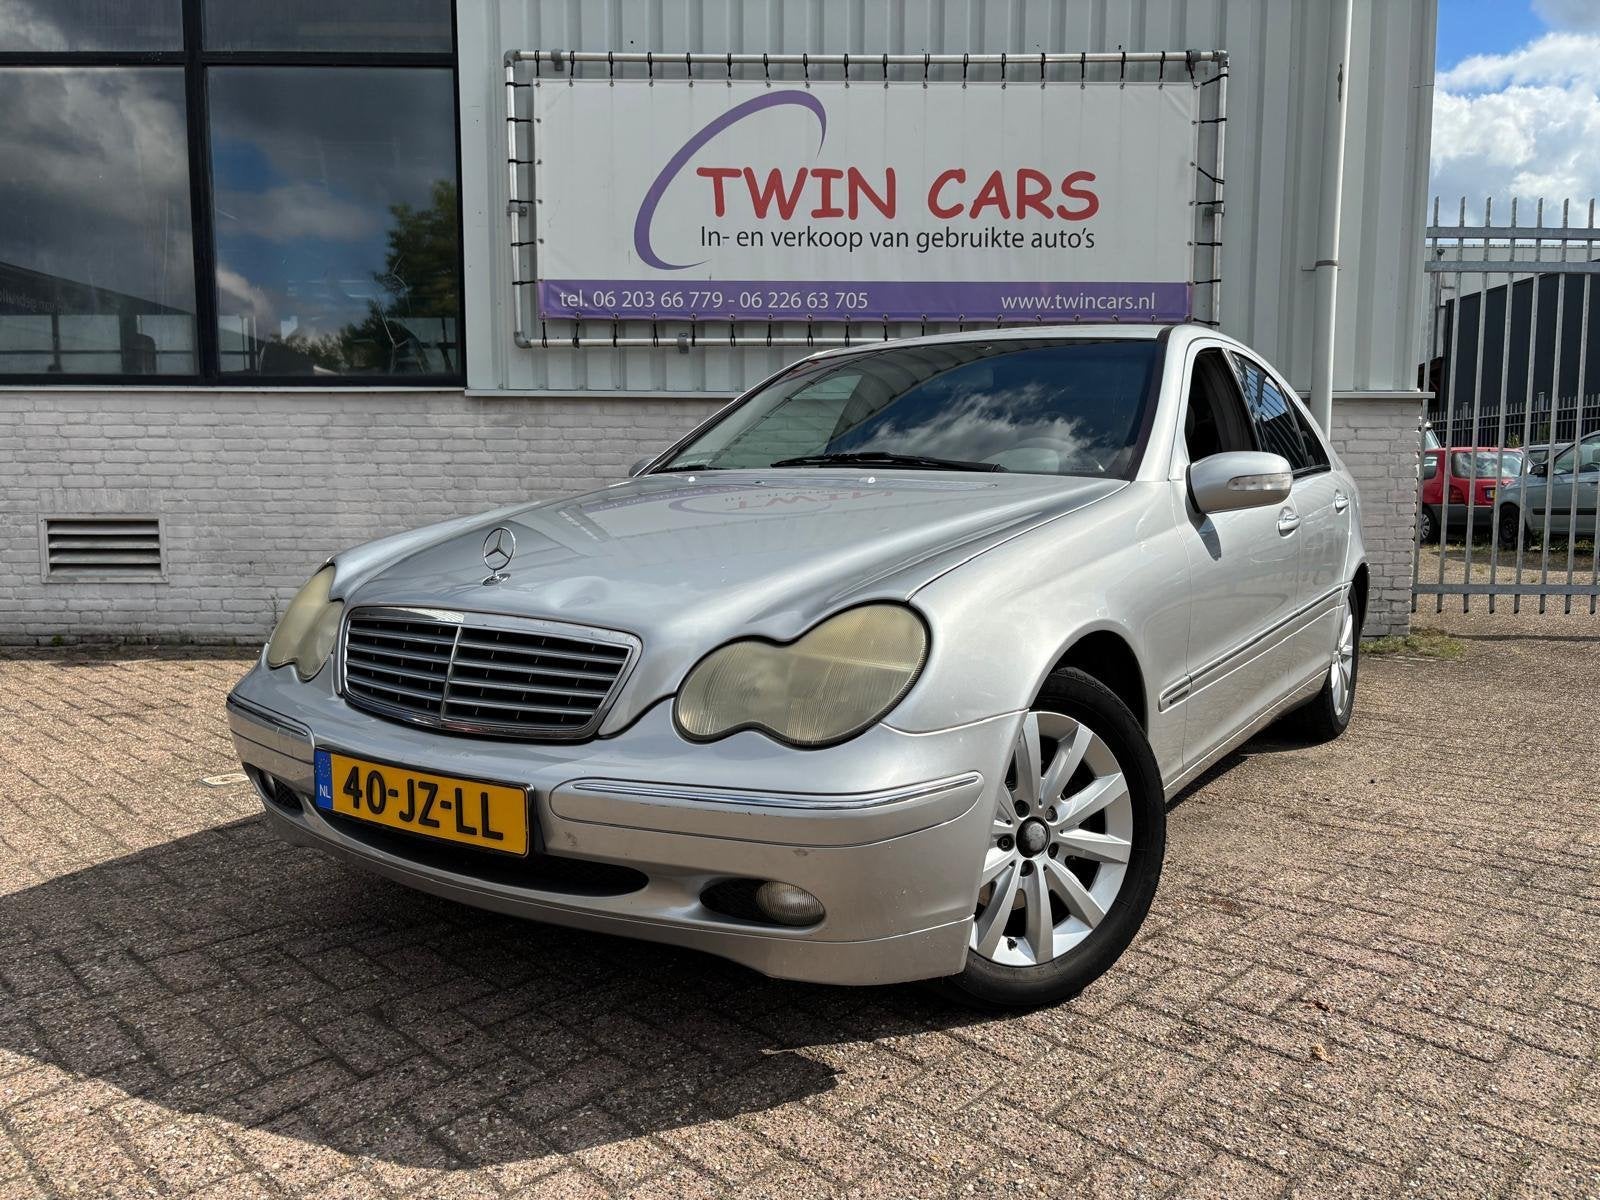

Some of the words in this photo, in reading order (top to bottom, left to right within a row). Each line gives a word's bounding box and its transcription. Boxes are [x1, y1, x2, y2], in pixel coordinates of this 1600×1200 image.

[697, 167, 896, 220] TWIN
[927, 168, 1099, 221] CARS
[701, 226, 730, 247] In-
[736, 231, 764, 247] en
[770, 226, 863, 252] verkoop
[870, 231, 909, 247] van
[916, 226, 1024, 253] gebruikte
[560, 289, 588, 308] tel.
[593, 291, 616, 308] 06
[622, 291, 655, 308] 203
[661, 291, 684, 308] 66
[689, 292, 722, 309] 779
[740, 292, 762, 309] 06
[768, 292, 801, 309] 226
[807, 292, 829, 309] 63
[835, 292, 868, 309] 705
[1001, 292, 1155, 310] www.twincars.nl
[319, 784, 332, 800] NL
[342, 765, 504, 841] 40-JZ-LL
